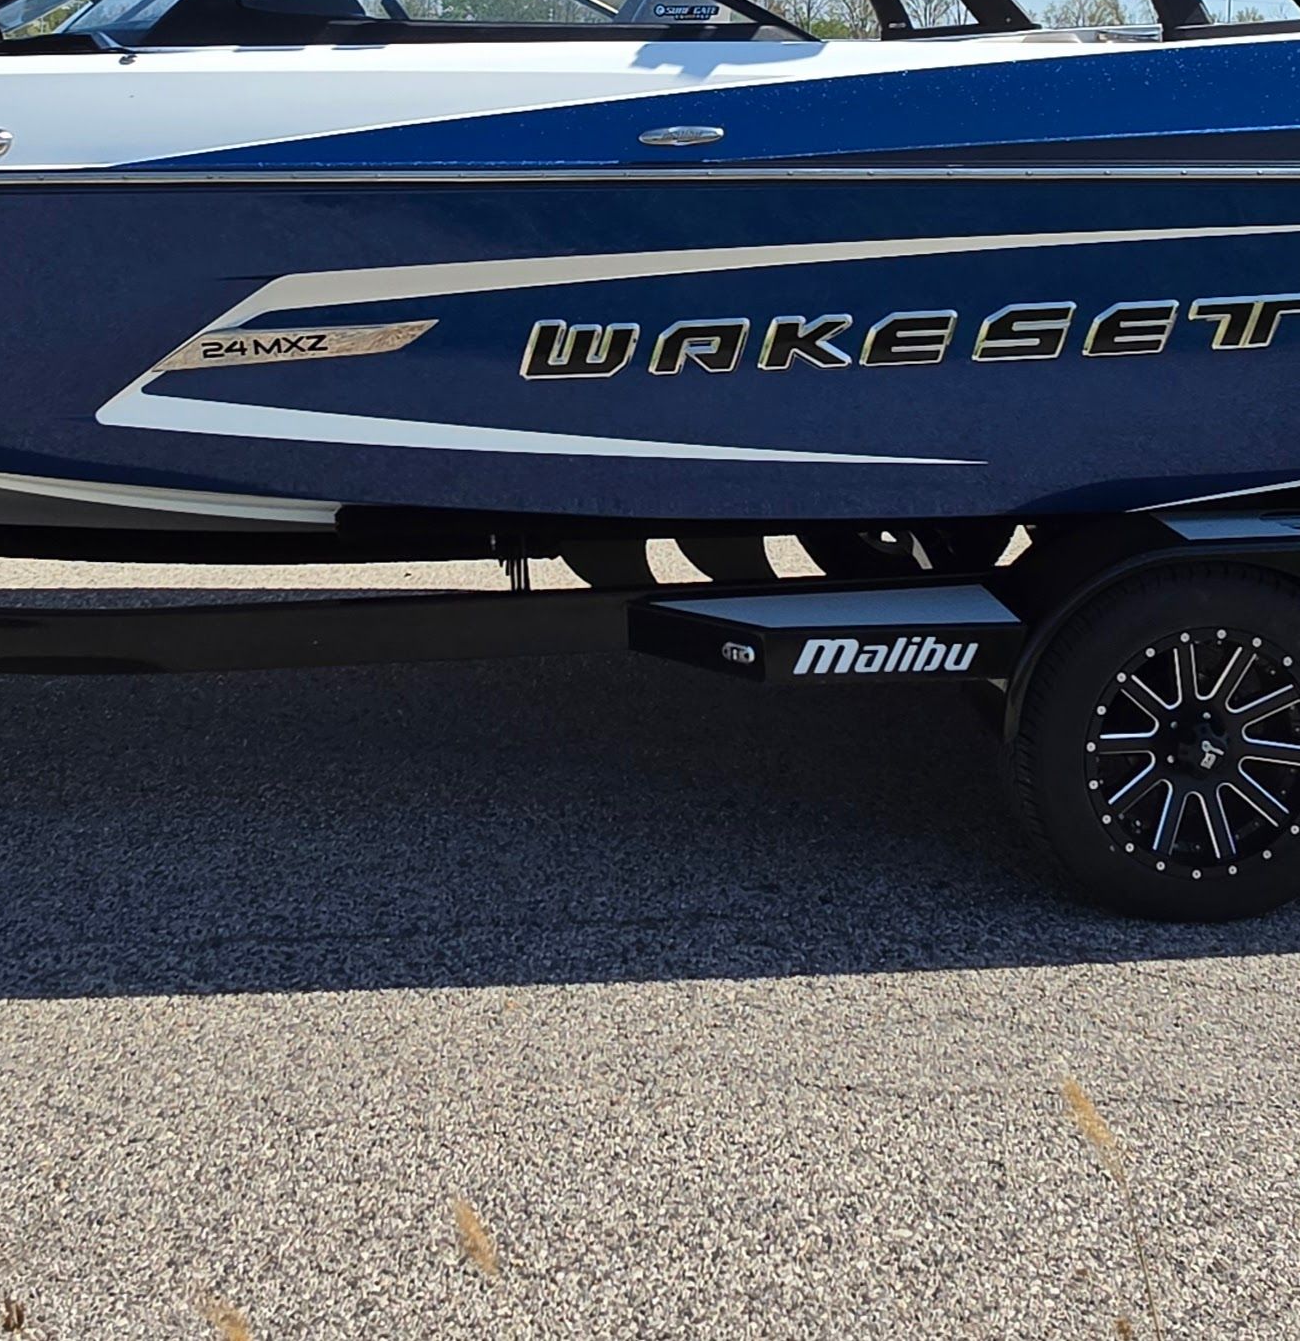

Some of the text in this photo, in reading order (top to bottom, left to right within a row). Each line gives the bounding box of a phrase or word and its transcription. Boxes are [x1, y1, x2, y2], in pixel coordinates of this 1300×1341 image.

[201, 334, 329, 358] 24 MXZ
[793, 636, 979, 675] Malibu
